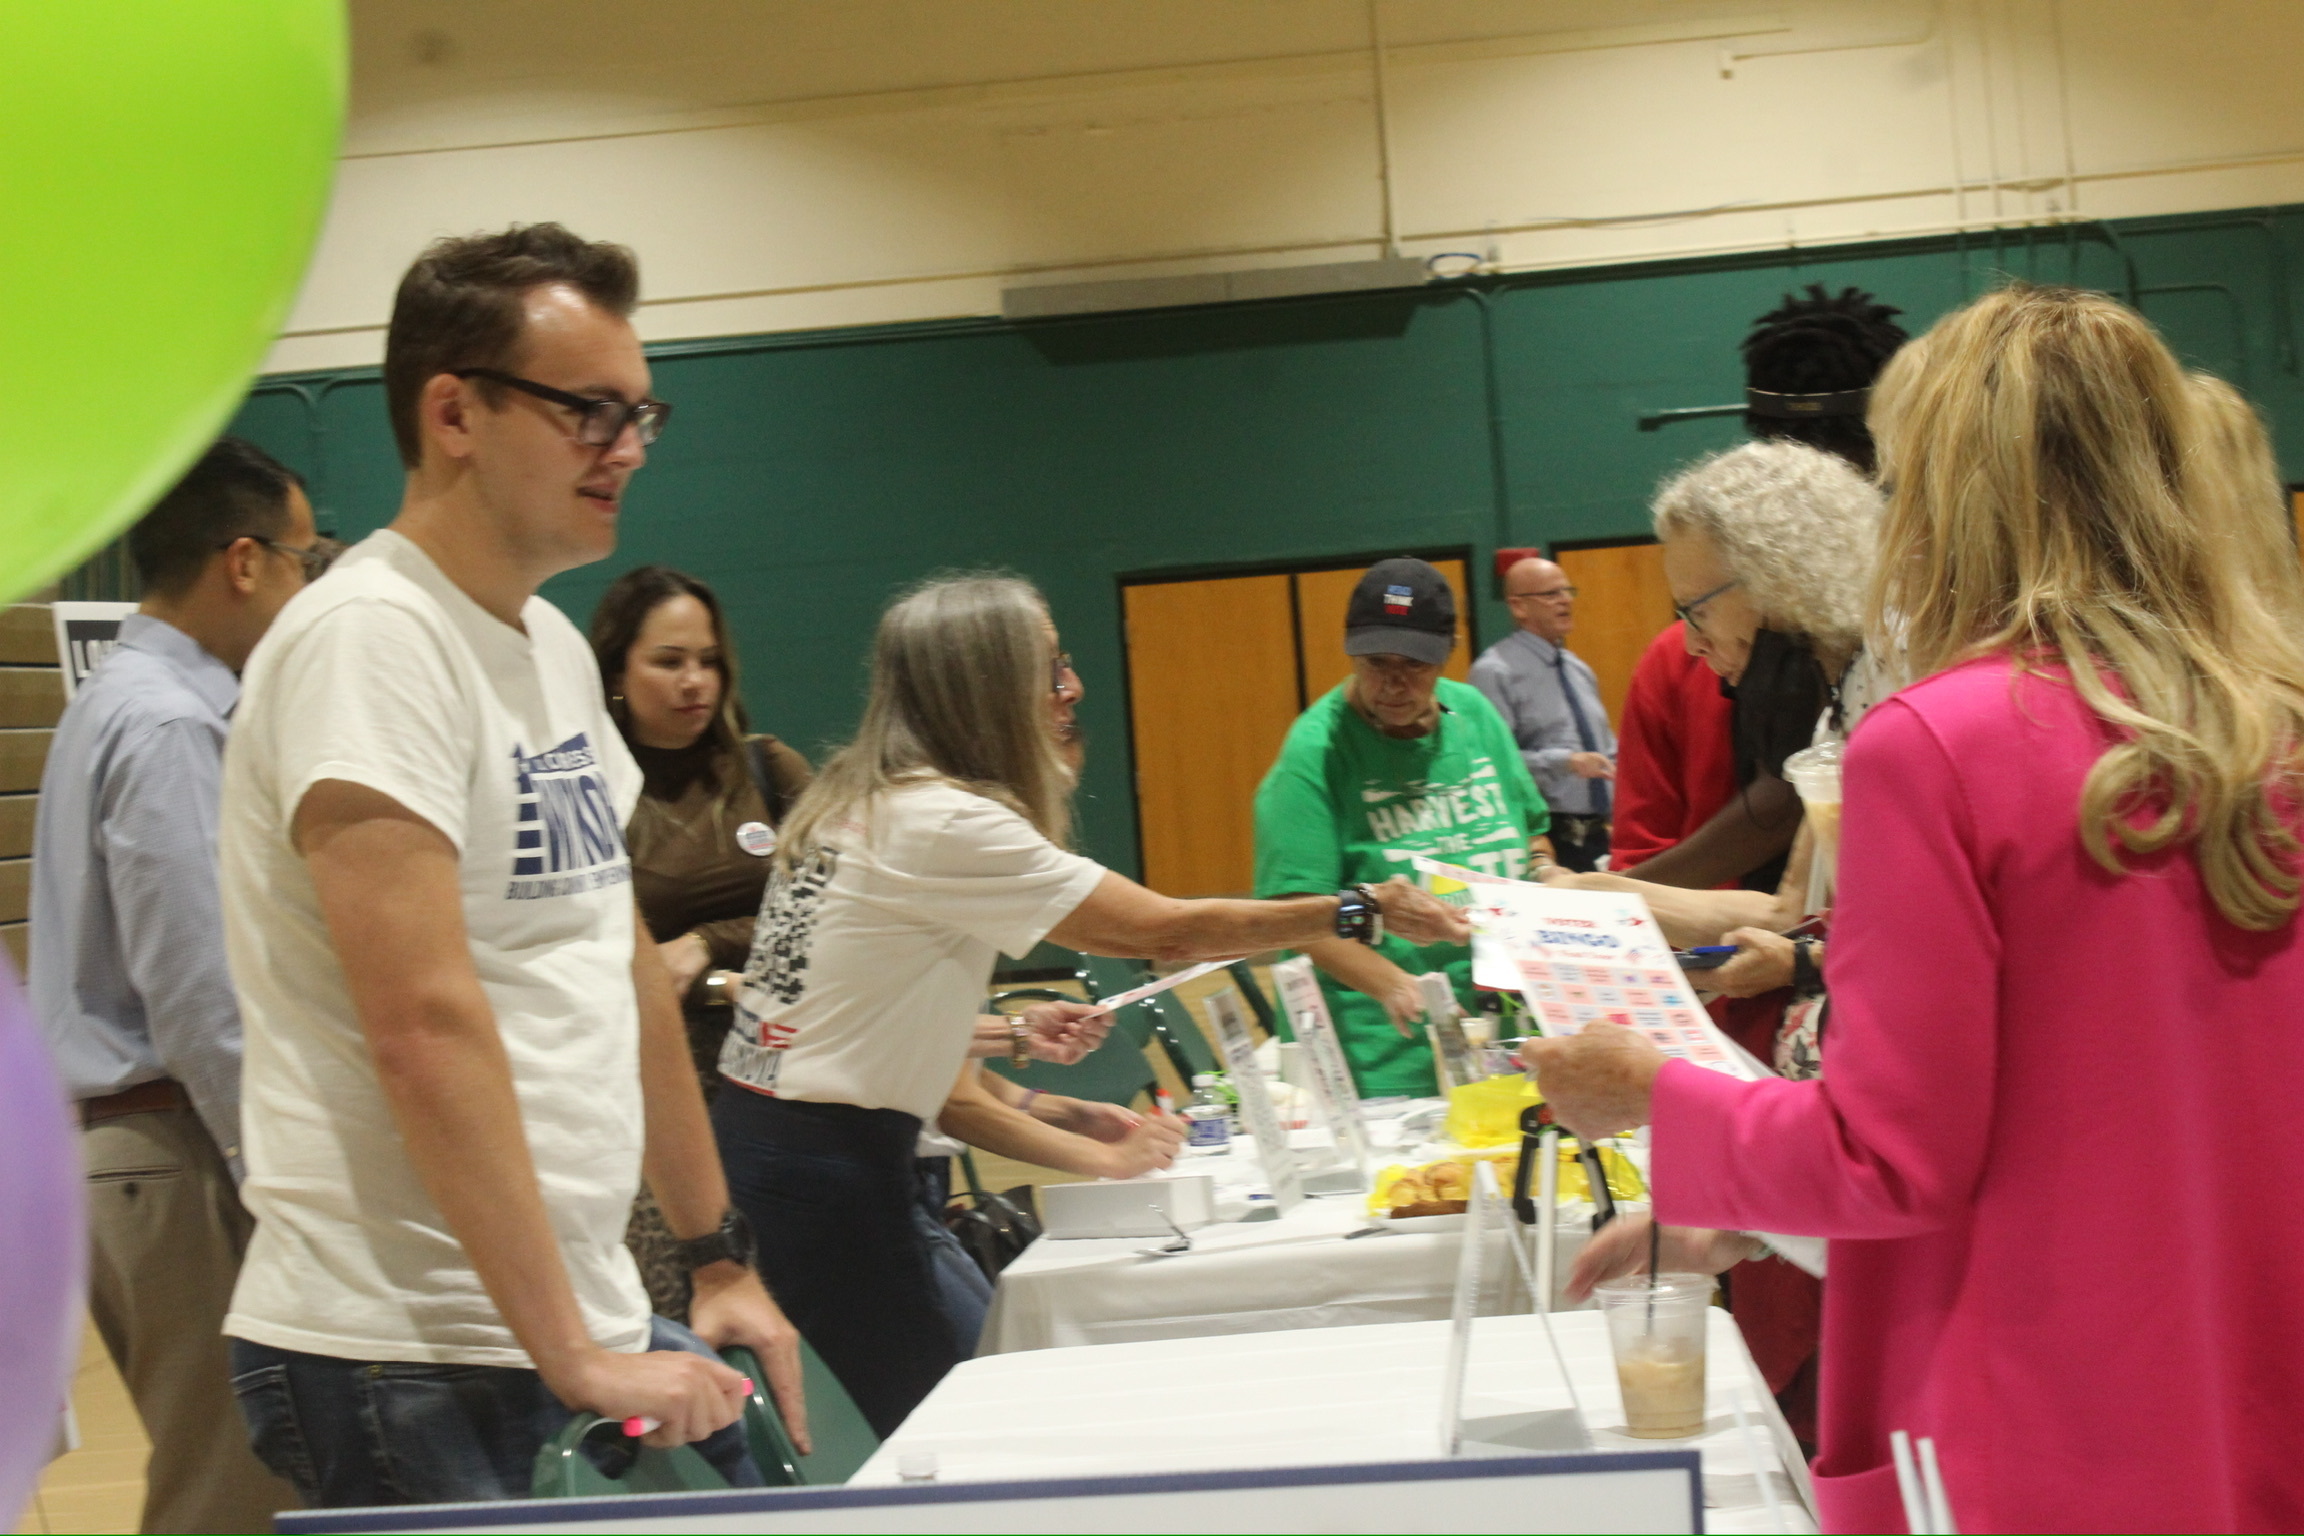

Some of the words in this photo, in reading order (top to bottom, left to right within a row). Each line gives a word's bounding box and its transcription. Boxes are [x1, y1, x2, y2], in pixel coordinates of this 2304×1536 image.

[1366, 783, 1508, 843] HARVEST
[1434, 832, 1475, 855] THE
[1535, 929, 1623, 949] BINGO
